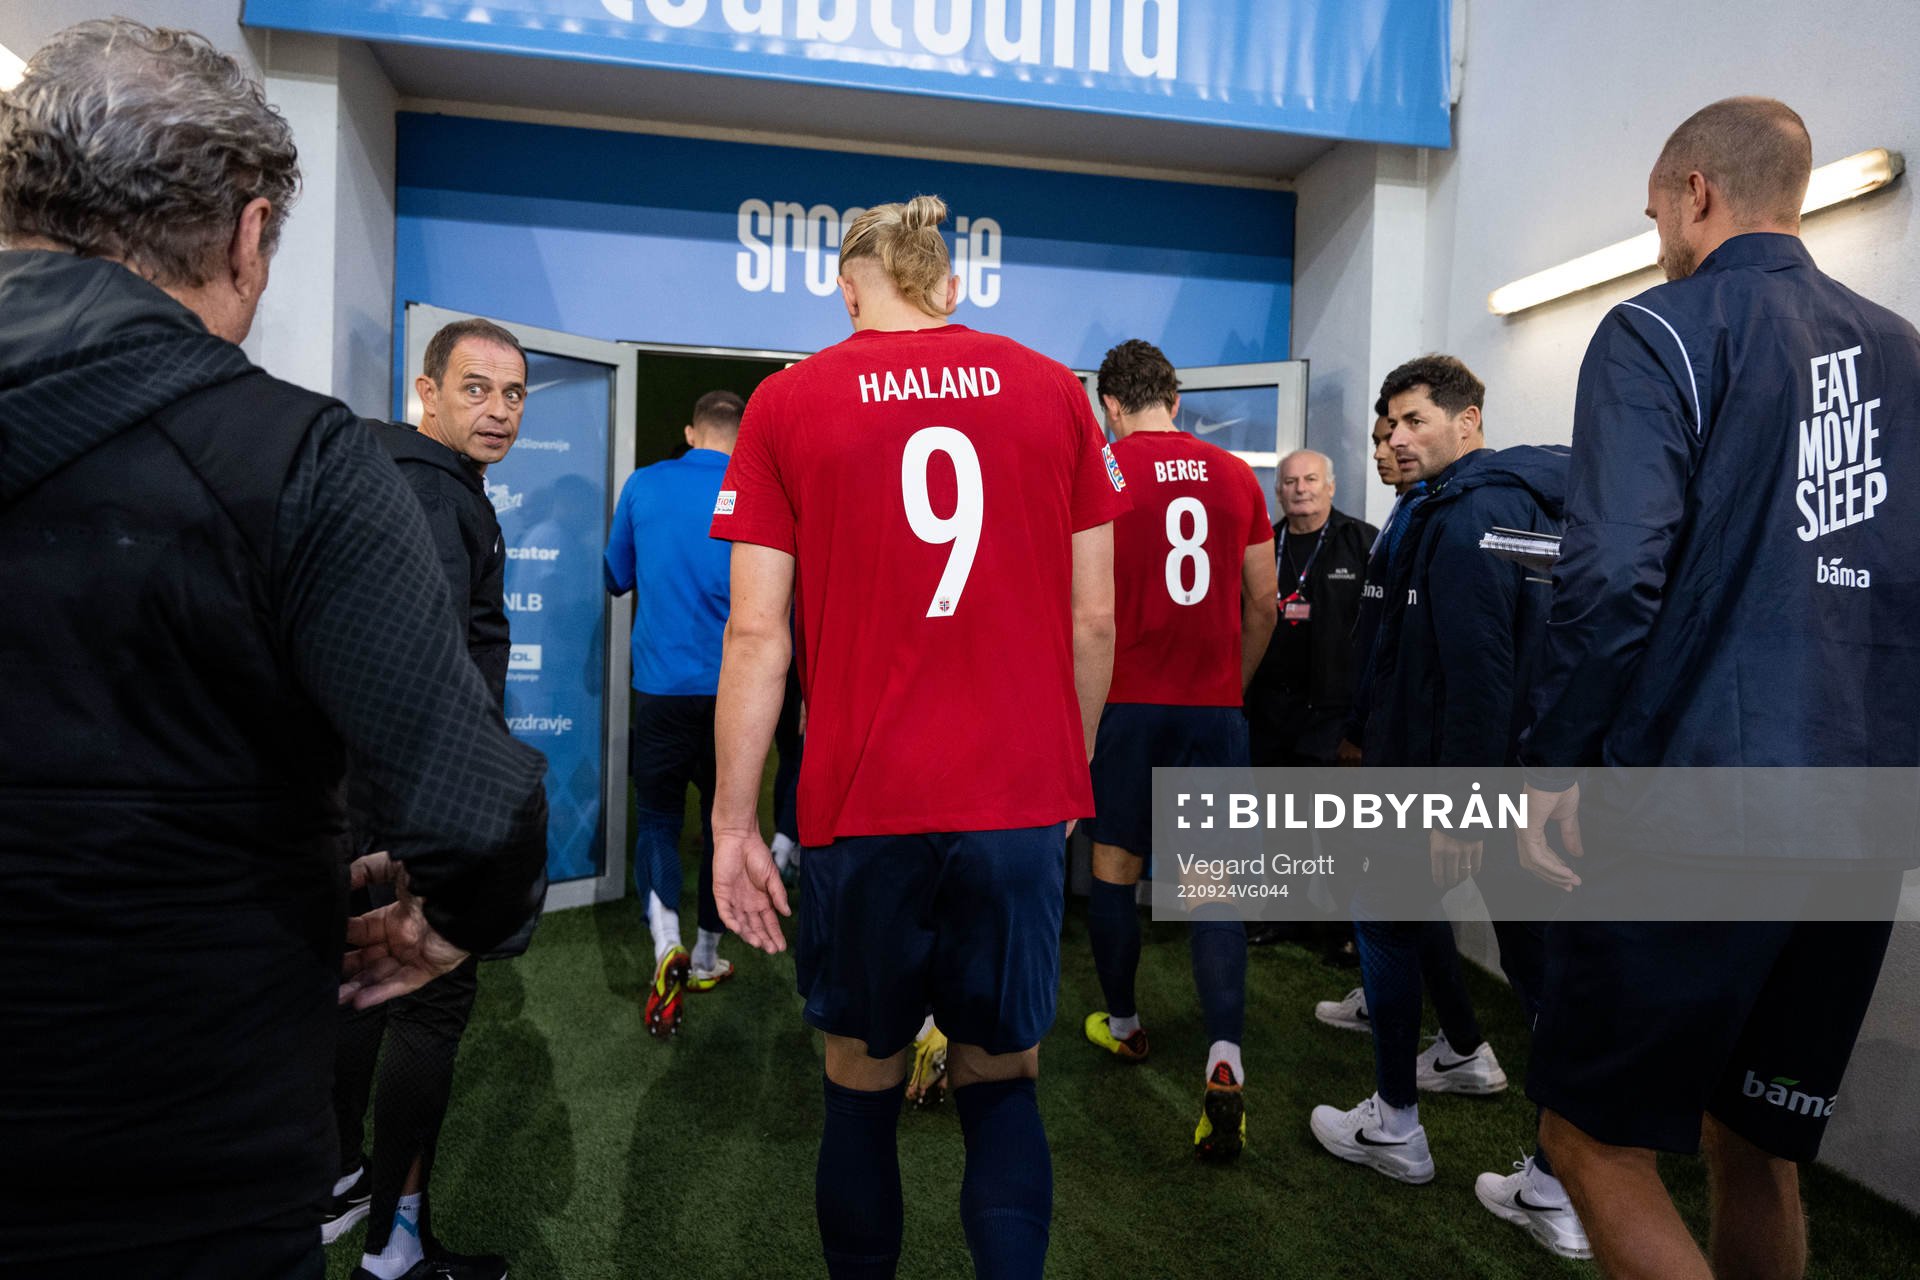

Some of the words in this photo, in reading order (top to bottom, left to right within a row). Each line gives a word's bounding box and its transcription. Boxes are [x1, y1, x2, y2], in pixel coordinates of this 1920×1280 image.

[858, 366, 1001, 403] HAALAND
[1810, 345, 1862, 418] EAT
[1155, 459, 1209, 484] BERGE
[1798, 398, 1882, 487] MOVE
[901, 426, 984, 618] 9
[1796, 463, 1888, 542] SLEEP
[506, 546, 560, 560] cator
[1165, 497, 1211, 606] 8
